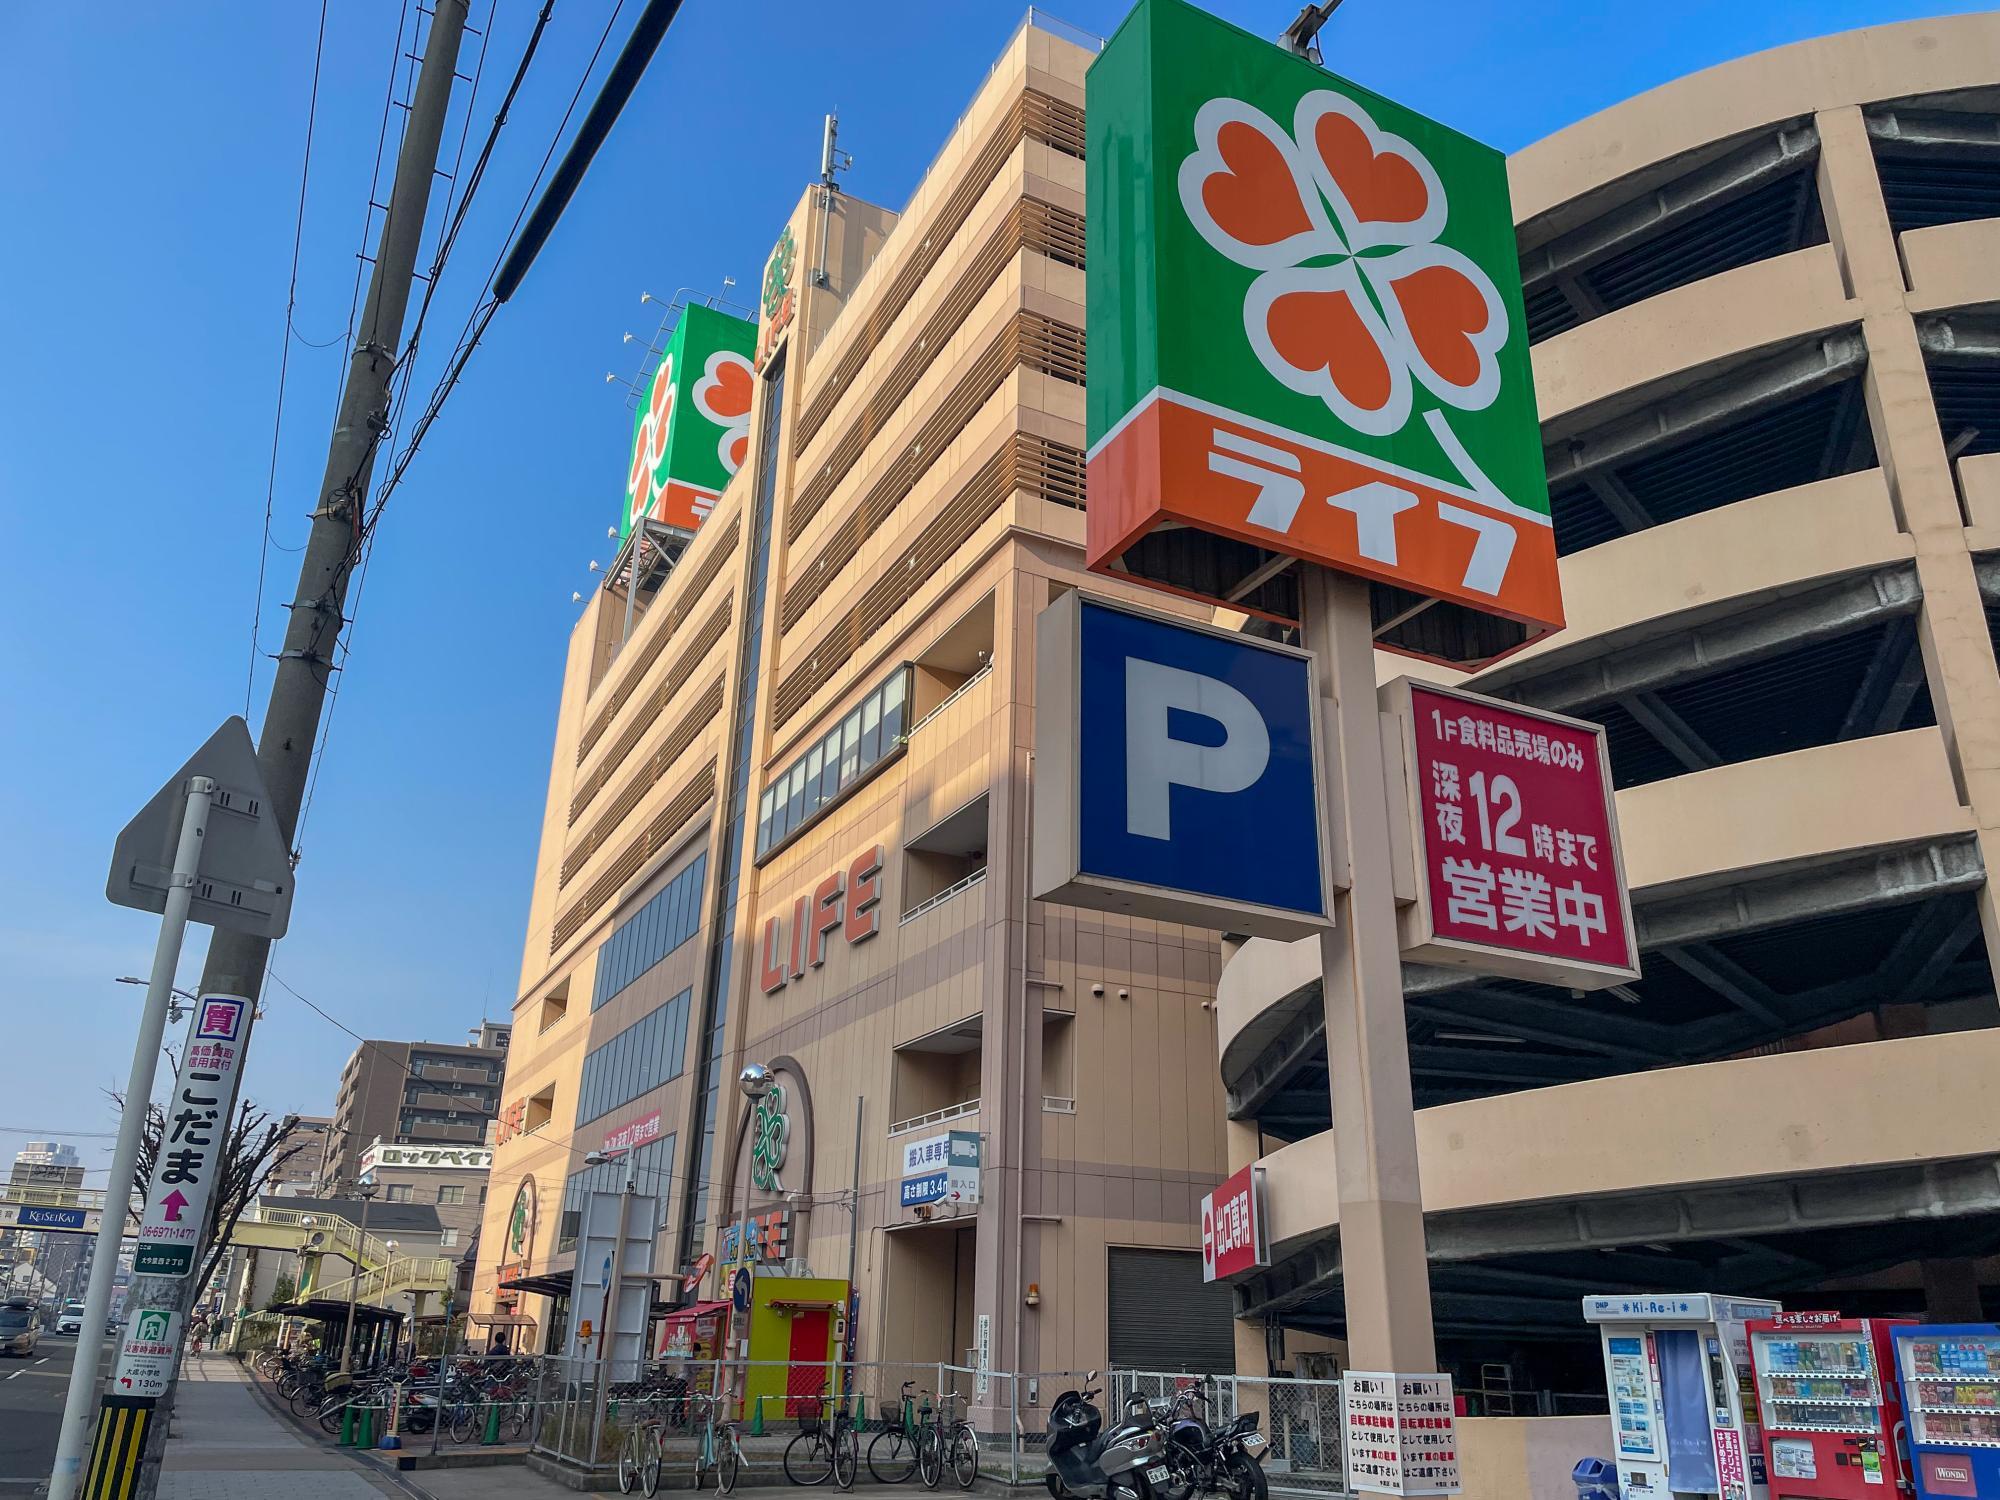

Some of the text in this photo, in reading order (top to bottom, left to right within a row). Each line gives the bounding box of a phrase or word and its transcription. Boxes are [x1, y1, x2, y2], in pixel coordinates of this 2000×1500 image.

[1208, 428, 1518, 597] ライフ
[1432, 709, 1584, 772] 1F食料品売場のみ
[1126, 656, 1271, 841] P
[1442, 856, 1607, 946] 営業中
[761, 844, 884, 993] LIFE
[203, 1004, 236, 1035] 質
[191, 1045, 234, 1059] 高価買取
[188, 1057, 231, 1071] 信用貸付
[161, 1072, 221, 1184] こだま
[495, 1097, 527, 1146] LIFE
[1216, 1190, 1250, 1257] 出口専用
[138, 1380, 162, 1388] 130m
[1349, 1400, 1393, 1411] こちらの場所は
[1398, 1402, 1450, 1412] こちらの場所は
[1350, 1414, 1394, 1429] 自転車駐輪場
[1401, 1417, 1452, 1430] 自転車駐輪場
[1352, 1431, 1395, 1444] として使用して
[1401, 1434, 1453, 1445] として使用して
[1716, 1432, 1730, 1482] はじめました
[1353, 1463, 1398, 1477] はご遠慮下さい
[1404, 1467, 1456, 1478] はご遠慮下さい
[1937, 1468, 1965, 1479] WONDA
